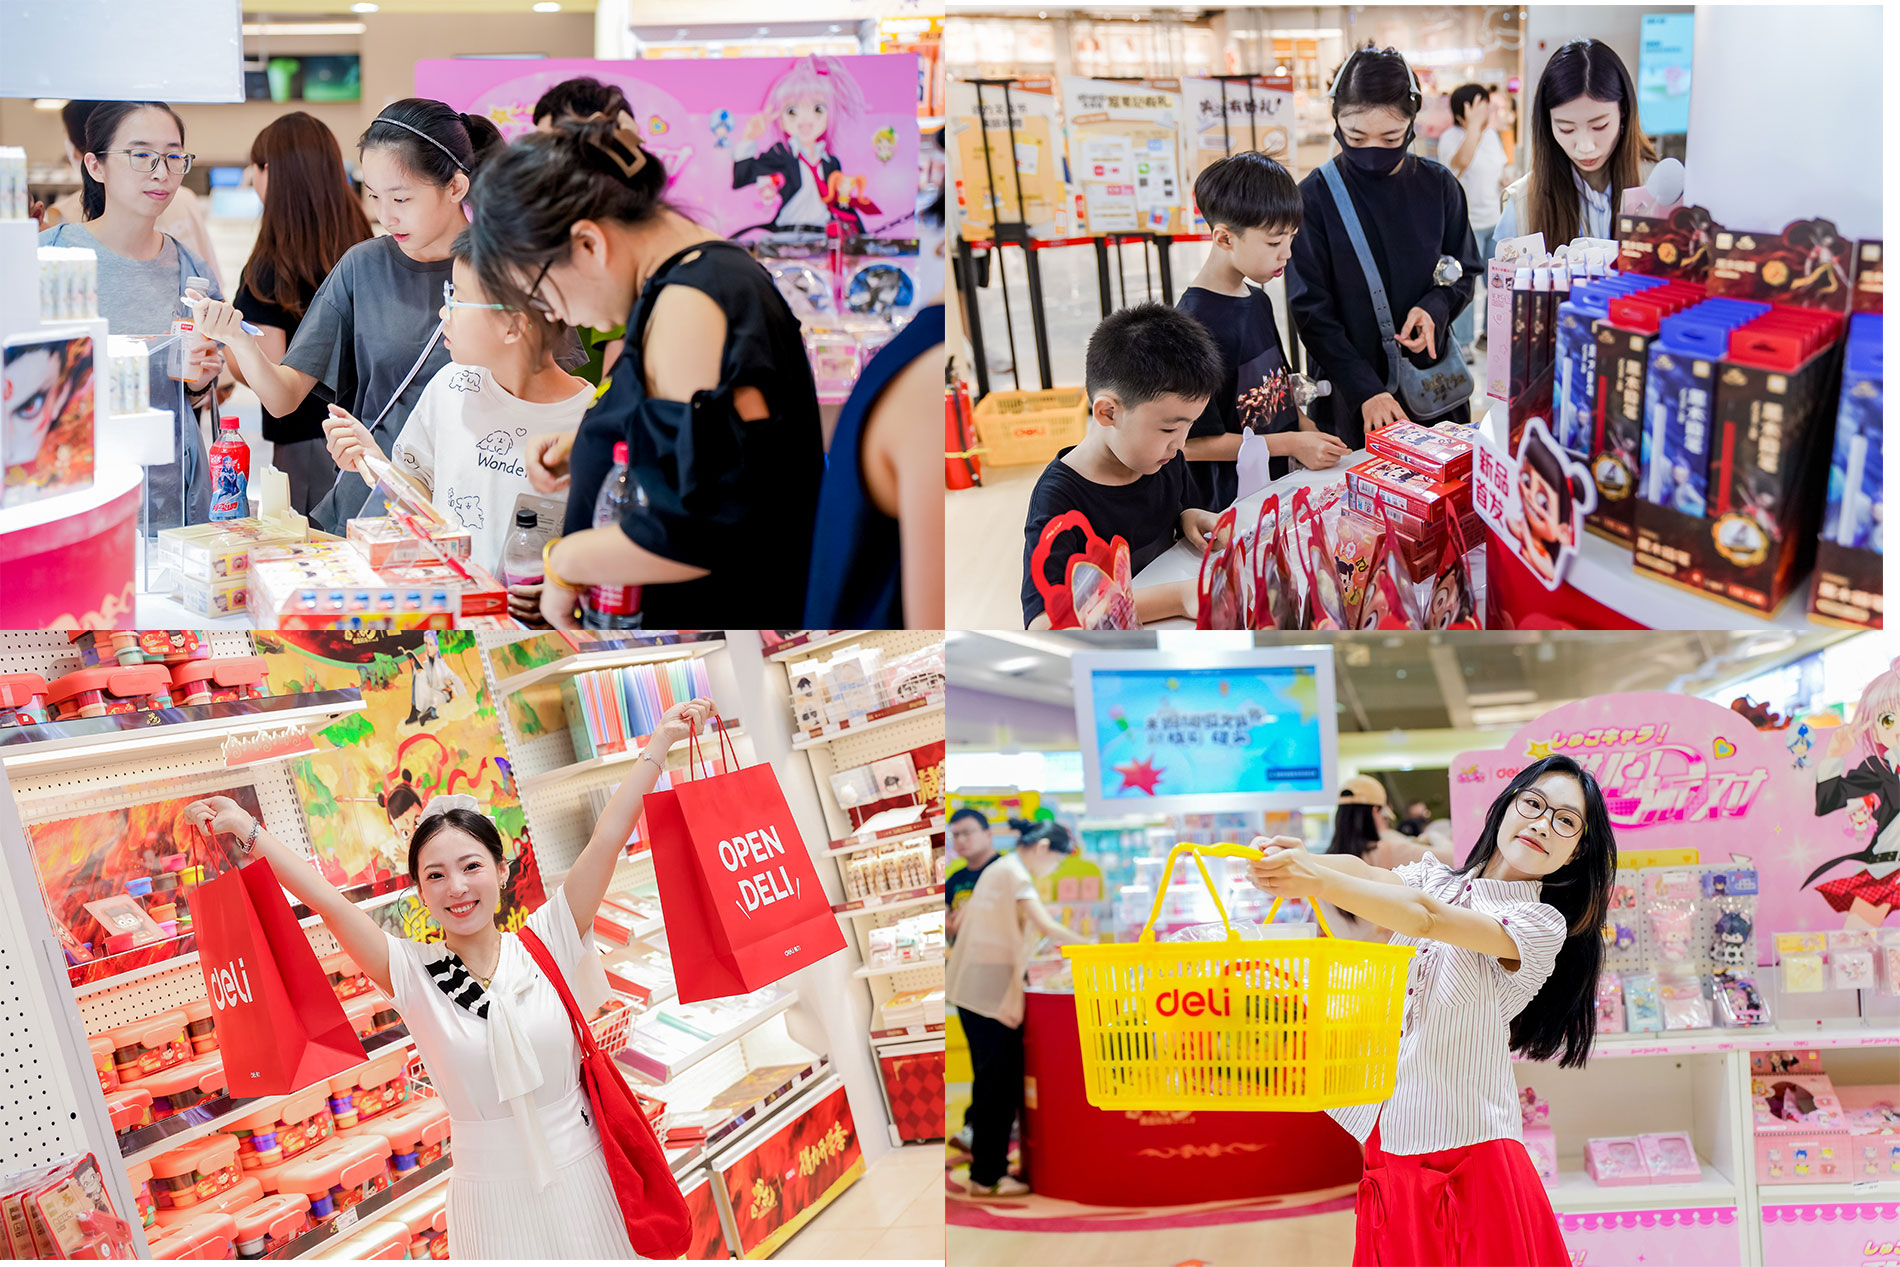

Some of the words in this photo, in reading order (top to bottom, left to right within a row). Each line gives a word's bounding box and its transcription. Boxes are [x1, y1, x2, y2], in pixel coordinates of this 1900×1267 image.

[478, 452, 528, 478] Wonde
[1479, 446, 1509, 497] 新品
[1475, 478, 1504, 528] 首发
[718, 825, 785, 872] OPEN
[737, 866, 795, 912] DELI
[210, 957, 253, 1011] deli
[1155, 988, 1230, 1017] deli
